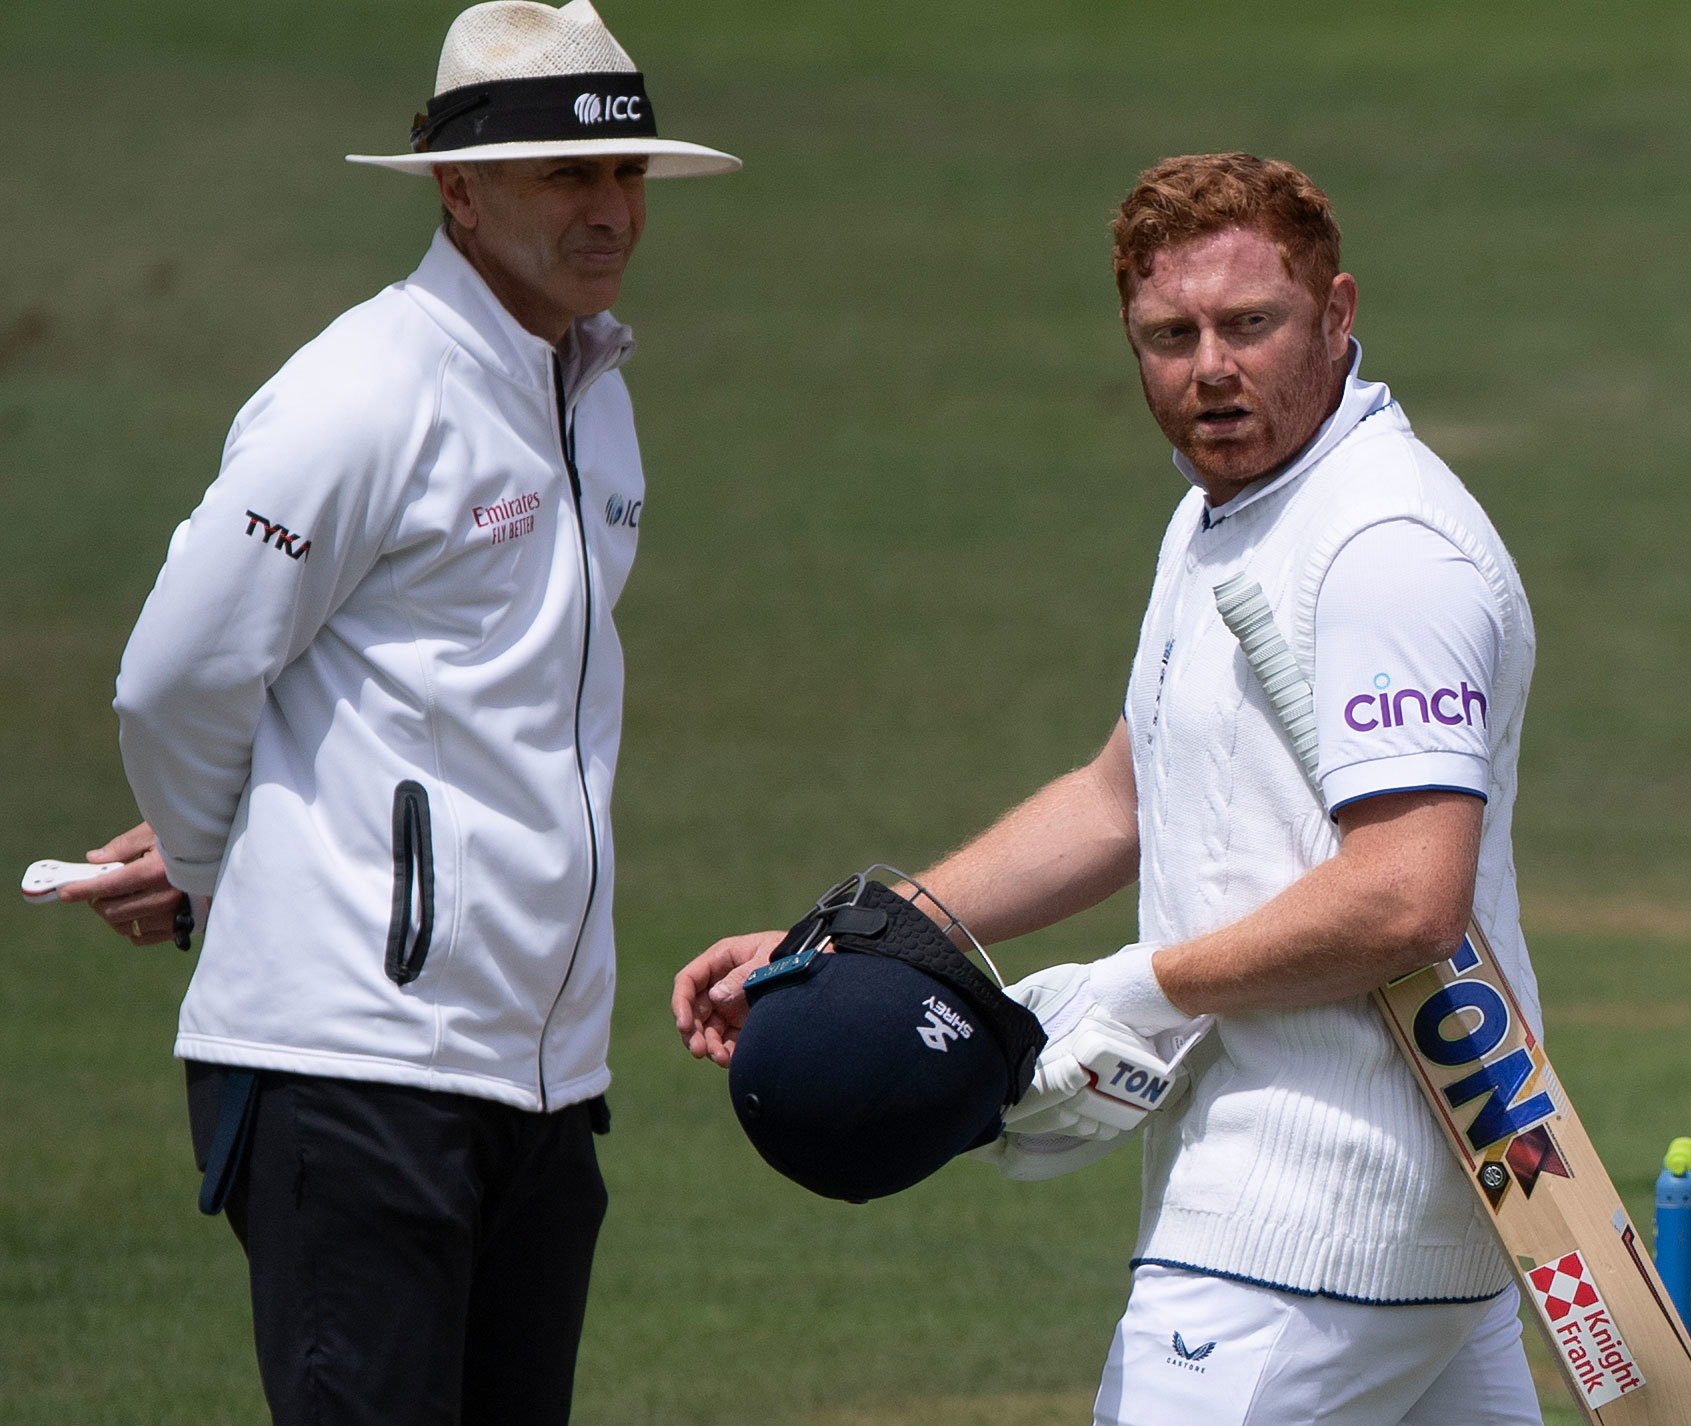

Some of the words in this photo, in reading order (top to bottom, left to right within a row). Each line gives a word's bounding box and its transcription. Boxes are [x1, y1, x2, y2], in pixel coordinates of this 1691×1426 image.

[604, 95, 642, 121] ICC
[472, 491, 541, 528] Emirates
[491, 523, 507, 545] FLY
[509, 515, 535, 540] BETTER
[622, 499, 642, 528] IC
[1344, 672, 1487, 732] cinch
[922, 995, 974, 1039] SHREY
[1110, 1060, 1170, 1104] TON
[1556, 1321, 1604, 1395] Frank
[1583, 1309, 1642, 1394] Knight
